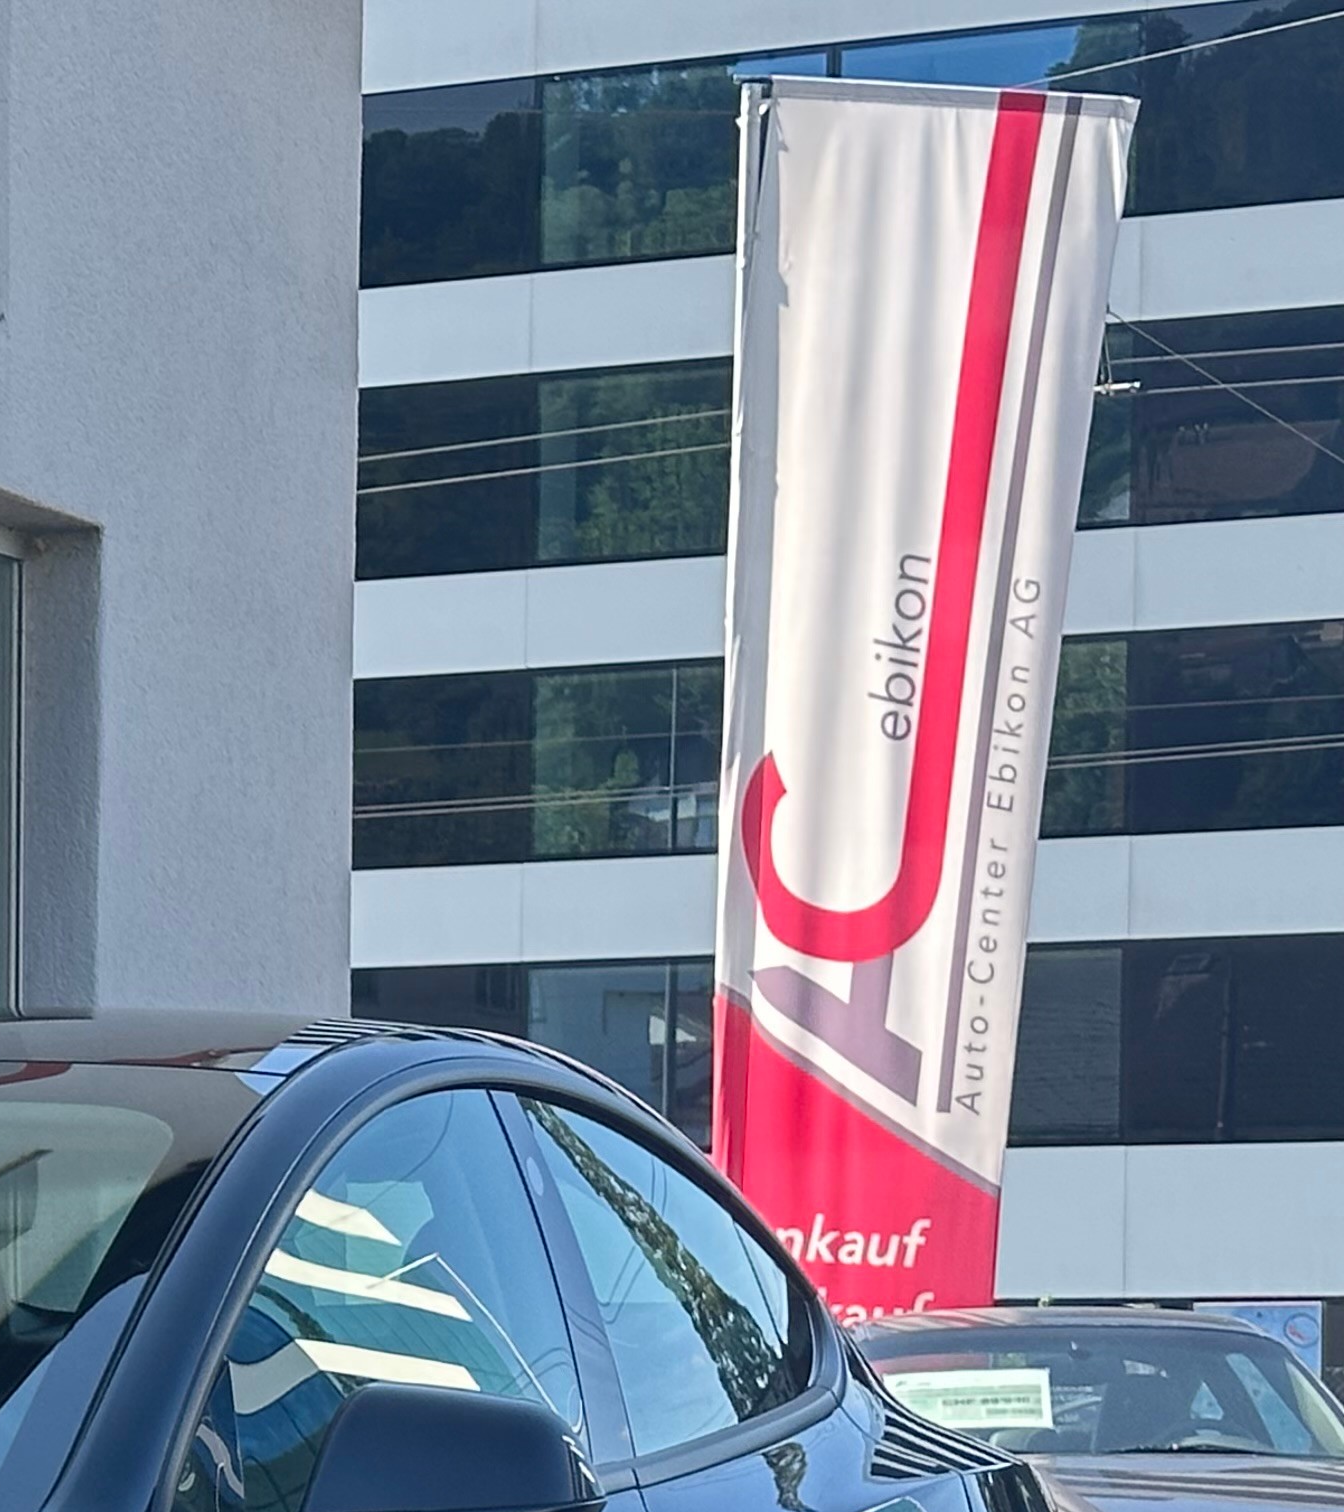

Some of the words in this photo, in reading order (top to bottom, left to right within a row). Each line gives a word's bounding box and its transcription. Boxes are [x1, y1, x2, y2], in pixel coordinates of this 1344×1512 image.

[866, 552, 932, 742] ebikon
[955, 836, 1009, 1116] Auto-Center
[987, 663, 1031, 814] Ebikon
[1010, 575, 1041, 640] AG
[774, 1213, 931, 1268] nkauf
